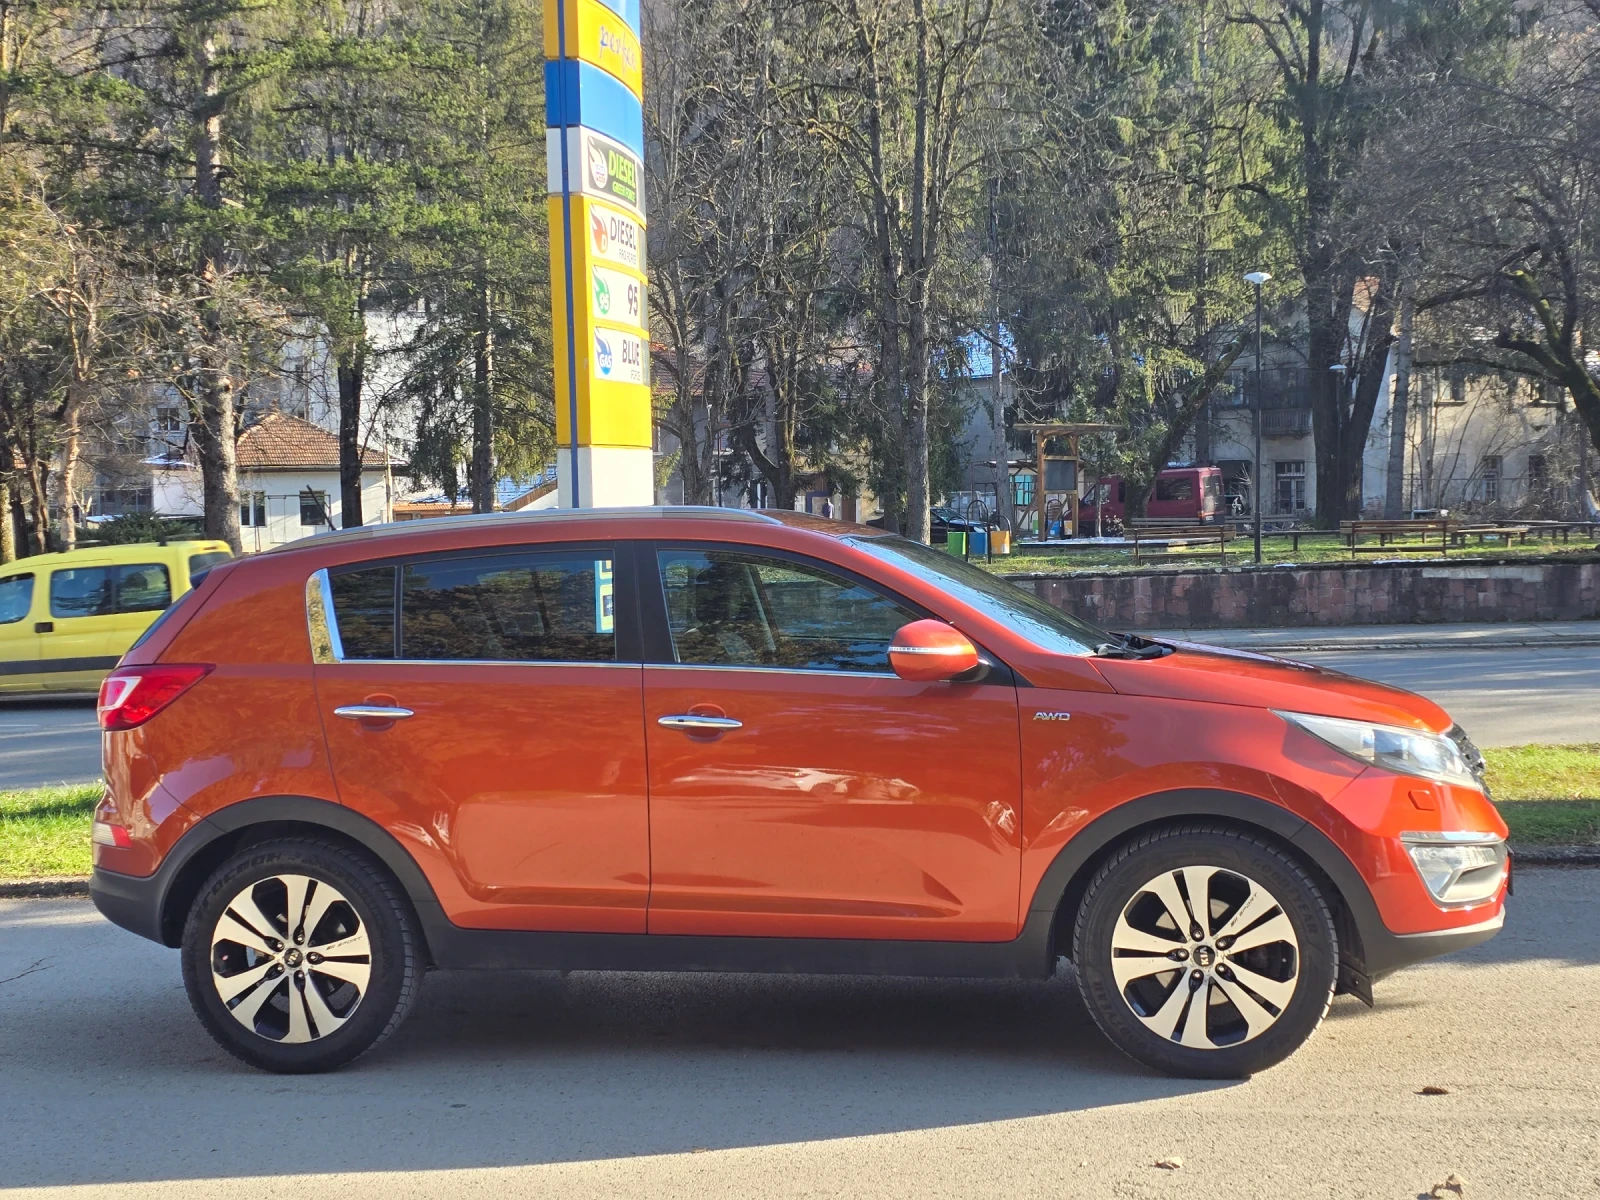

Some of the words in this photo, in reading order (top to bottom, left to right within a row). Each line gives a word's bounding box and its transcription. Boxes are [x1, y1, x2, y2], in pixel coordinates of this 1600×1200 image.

[608, 149, 636, 190] DIESEL
[610, 216, 637, 251] DIESEL
[599, 292, 610, 311] 95
[627, 283, 639, 317] 95
[600, 353, 612, 369] GAS
[622, 339, 640, 367] BLUE
[1032, 711, 1071, 721] AWD
